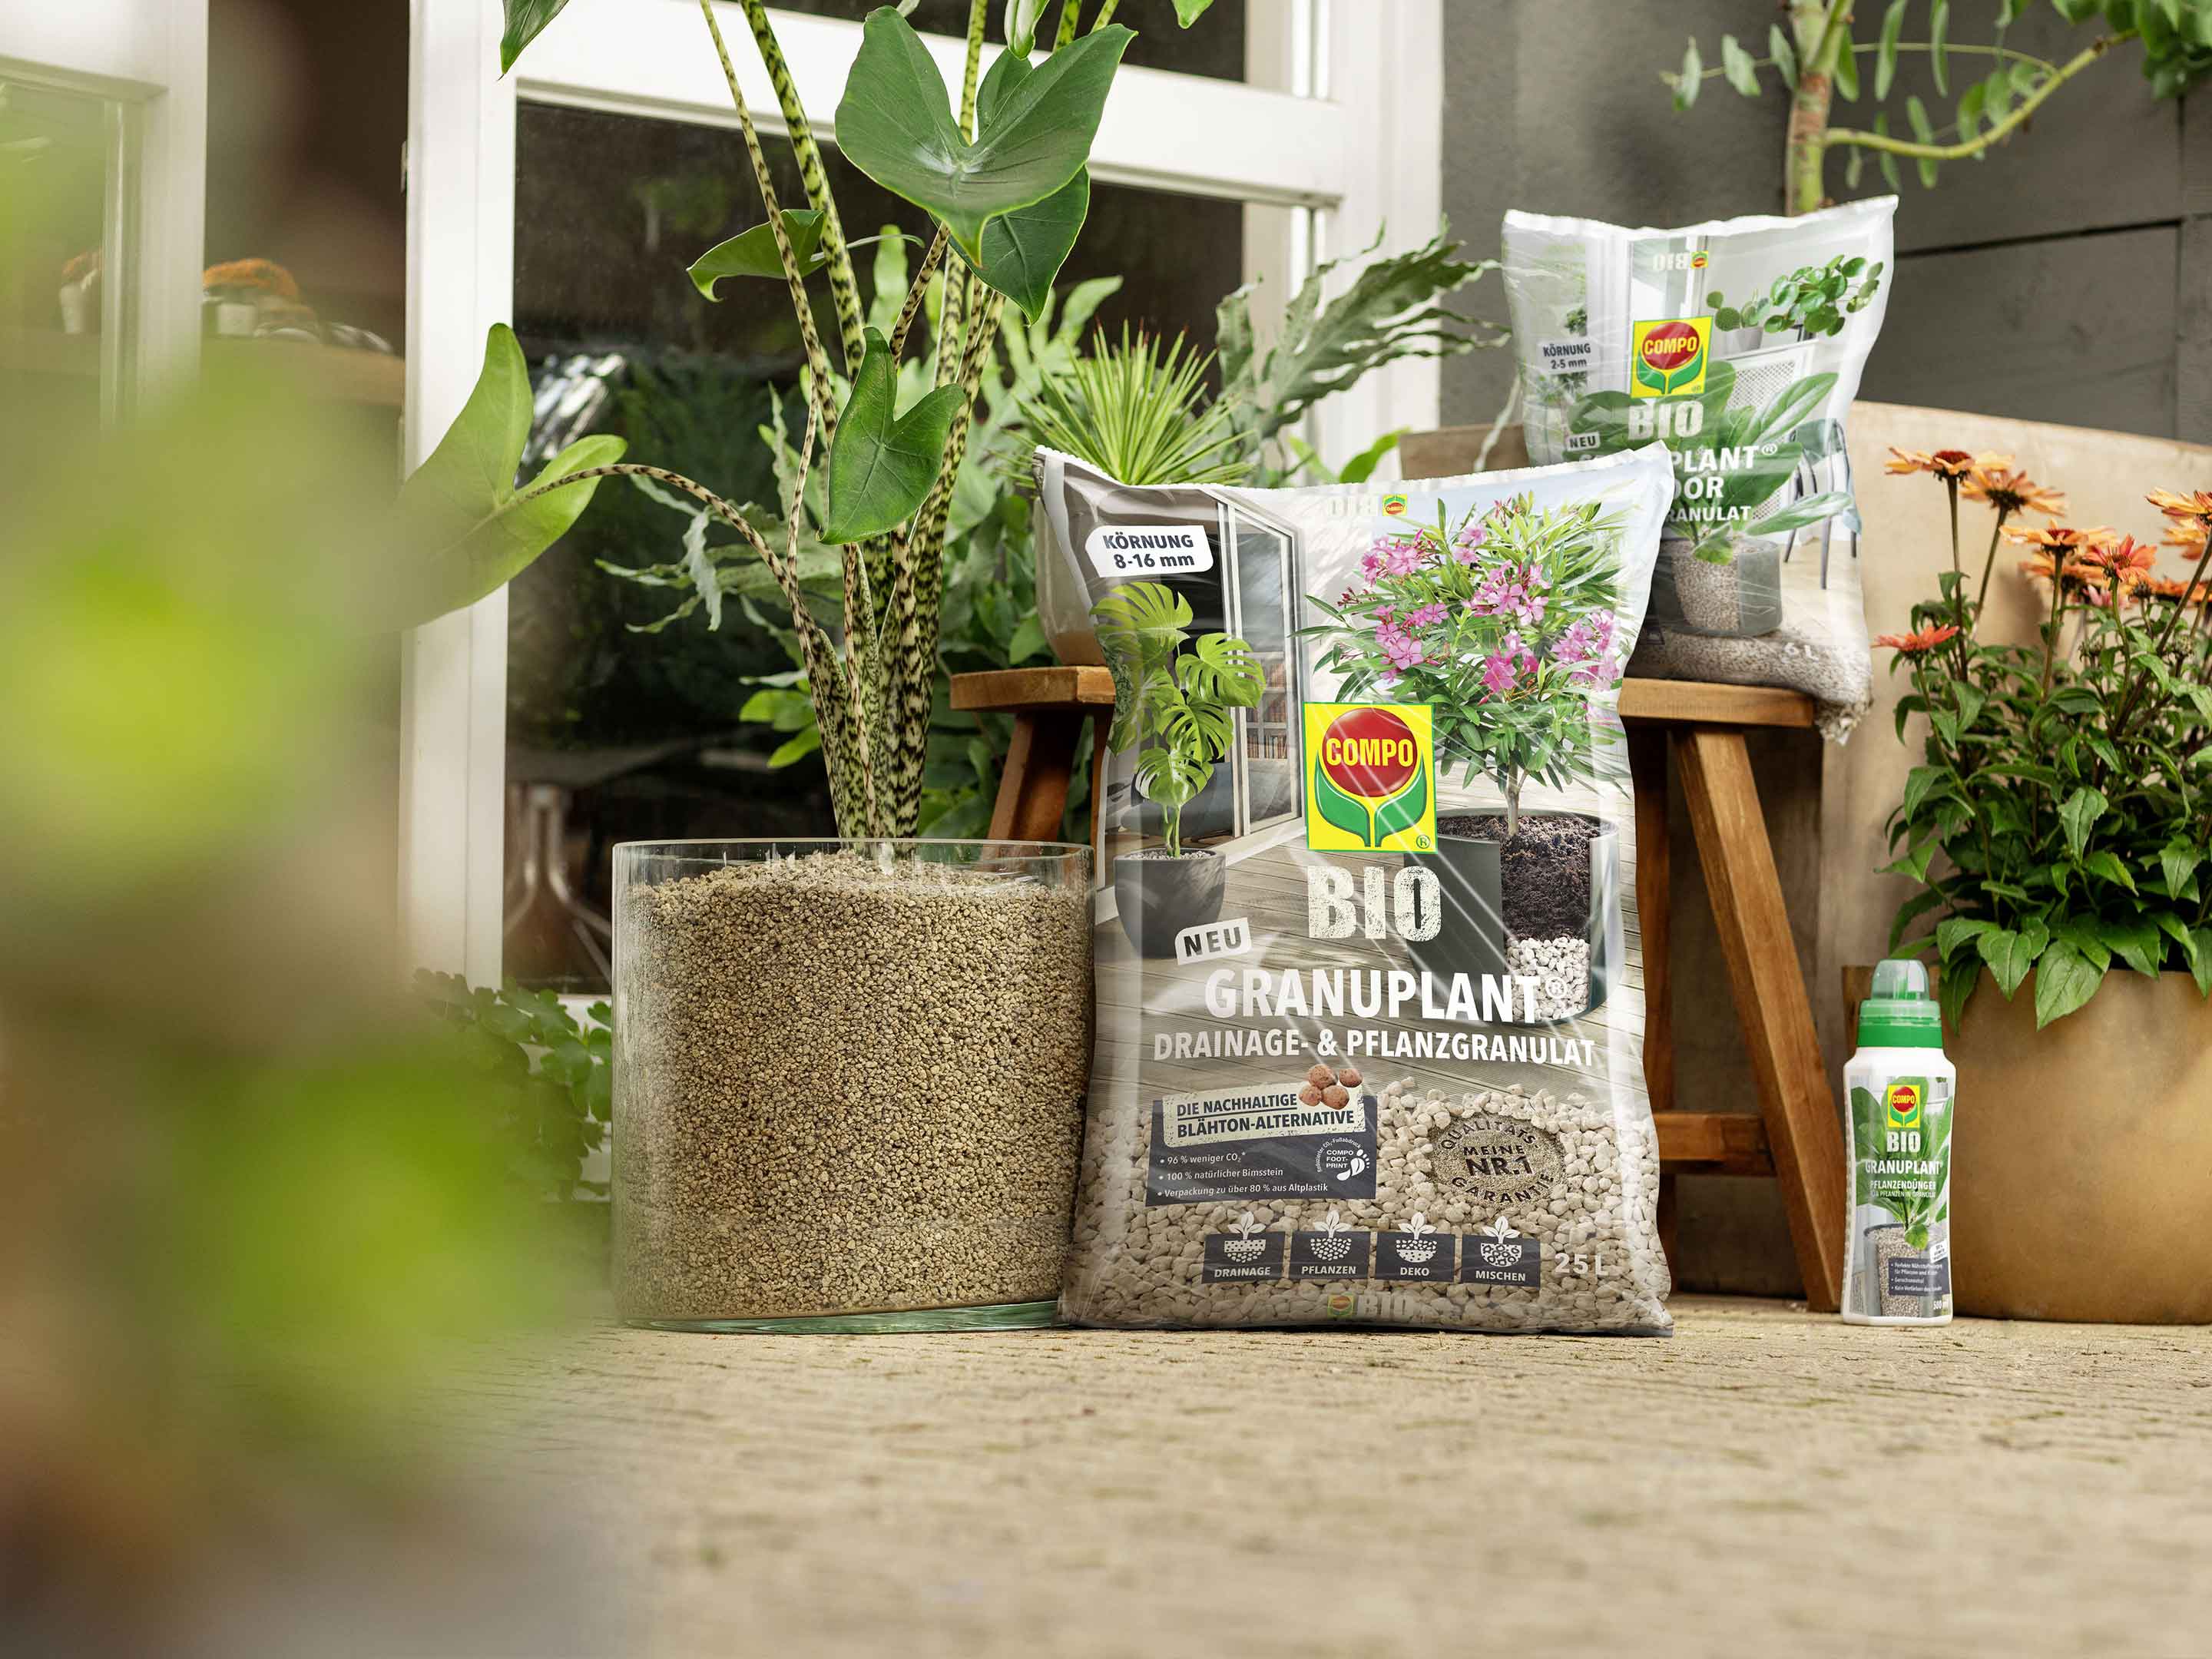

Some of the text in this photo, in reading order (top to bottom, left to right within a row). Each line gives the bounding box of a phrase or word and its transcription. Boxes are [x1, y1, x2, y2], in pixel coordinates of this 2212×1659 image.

[1543, 343, 1591, 357] KÖRNUNG
[1644, 336, 1697, 355] COMPO
[1550, 358, 1587, 369] 2-5 mm
[1628, 400, 1704, 440] BIO
[1569, 435, 1596, 449] NEU
[1103, 531, 1194, 550] KÖRNUNG
[1114, 554, 1195, 569] 8-16 mm
[1783, 642, 1799, 664] 6
[1326, 737, 1414, 767] COMPO
[1306, 866, 1442, 942] BIO
[1183, 926, 1243, 957] NEU
[1154, 1029, 1595, 1067] DRAINAGE- & PFLANZGRANULAT
[1177, 1093, 1297, 1116] DIE NACHHALTIGE
[1892, 1094, 1915, 1104] COMPO
[1177, 1110, 1355, 1138] BLÄHTON-ALTERNATIVE
[1463, 1145, 1525, 1155] MEINE
[1886, 1131, 1921, 1153] BIO
[1181, 1155, 1188, 1164] %
[1190, 1155, 1224, 1165] weniger
[1466, 1156, 1534, 1176] NR.1
[1167, 1167, 1283, 1181] 100 % natürlicher Bimsstein
[1164, 1188, 1214, 1197] Verpackung
[1289, 1183, 1329, 1193] Altplastik
[1452, 1174, 1554, 1203] GARANTIE
[1214, 1266, 1271, 1278] DRAINAGE
[1301, 1266, 1356, 1275] PFLANZEN
[1399, 1267, 1430, 1277] DEKO
[1554, 1253, 1588, 1275] 25
[1475, 1270, 1526, 1282] MISCHEN
